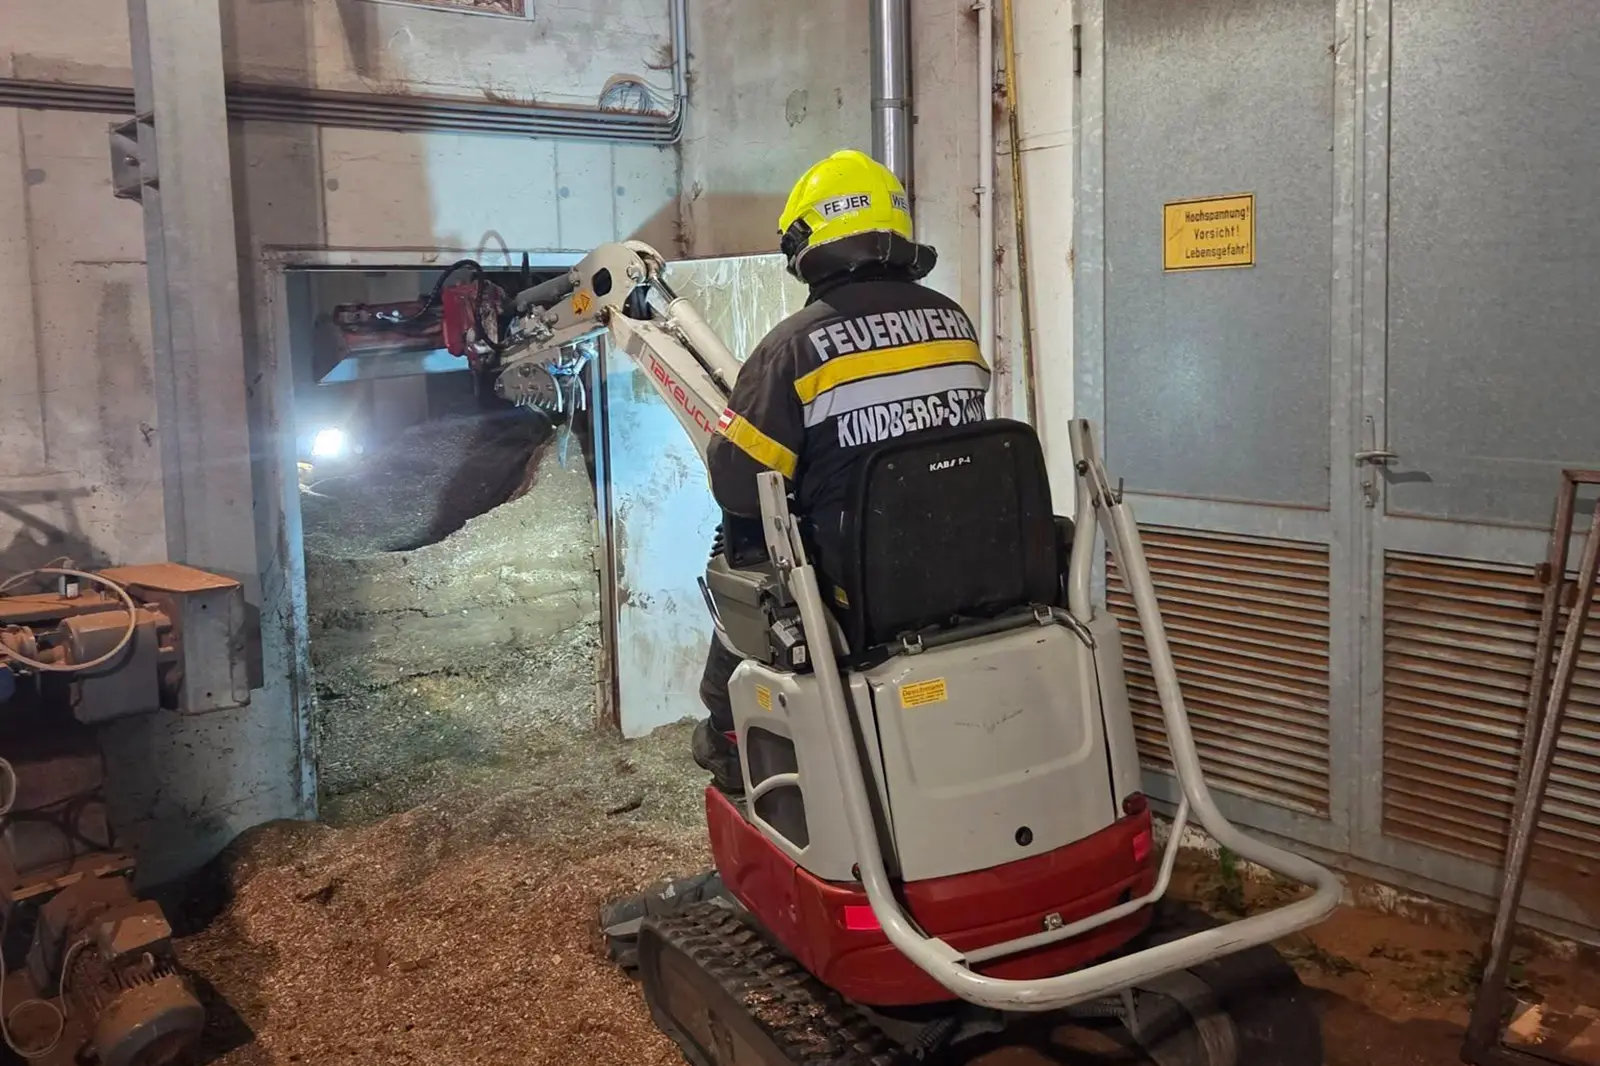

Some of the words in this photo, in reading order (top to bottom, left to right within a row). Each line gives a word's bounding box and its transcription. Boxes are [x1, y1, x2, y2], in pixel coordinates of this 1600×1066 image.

[1184, 205, 1250, 223] Hochspannung!
[1193, 225, 1240, 240] Vorsicht!
[1185, 242, 1250, 260] Lebensgefahr!
[808, 308, 976, 362] FEUERWEHR
[837, 390, 987, 448] KINDBERG-STAD
